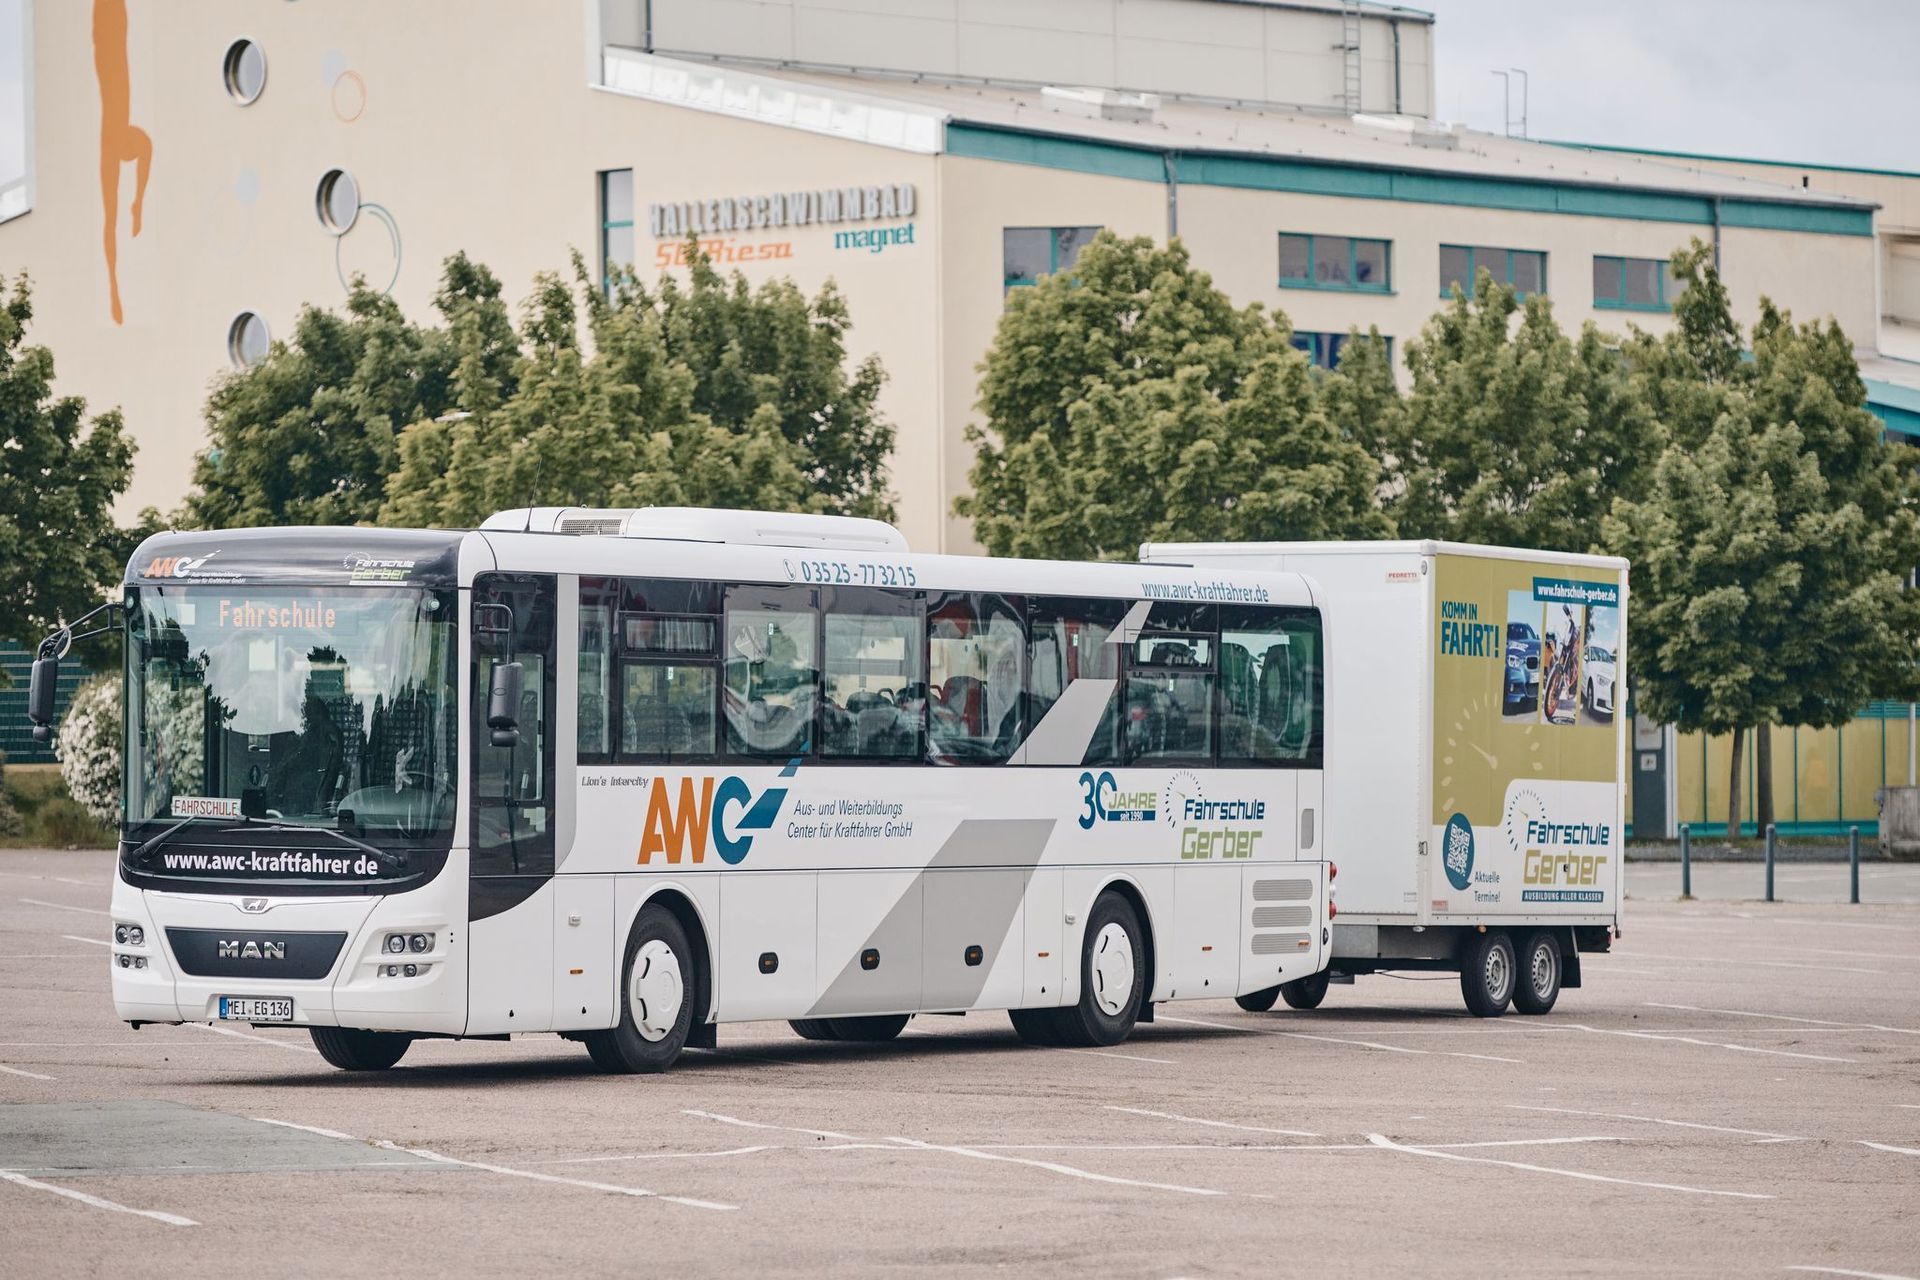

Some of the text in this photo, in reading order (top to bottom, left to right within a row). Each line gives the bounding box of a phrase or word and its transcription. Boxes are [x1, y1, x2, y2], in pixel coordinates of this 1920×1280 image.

[650, 183, 917, 238] HALLENSCHWIMMBAD
[834, 223, 914, 252] magnet
[143, 556, 193, 579] AWC
[351, 568, 411, 581] Gerber
[355, 559, 415, 572] Fahrschule
[1142, 580, 1269, 602] www.awc-kraftfahrer.de
[1537, 584, 1616, 603] www.fahrschule-gerber.de
[219, 599, 336, 629] Fahrschule
[1441, 600, 1478, 620] KOMM IN
[1441, 621, 1499, 658] FAHRT!
[581, 776, 607, 787] Lion's
[174, 799, 238, 816] FAHRSCHULE
[794, 799, 903, 819] Aus- und Weiterbildungs
[1078, 771, 1157, 829] 30 JAHRE
[1184, 798, 1265, 820] Fahrschule
[637, 775, 753, 865] AWC
[787, 820, 913, 838] Center für Kraftfahrer GmbH
[1526, 820, 1610, 845] Fahrschule
[1181, 827, 1263, 859] Gerber
[1474, 871, 1500, 883] Aktuelle
[1523, 849, 1607, 885] Gerber
[1474, 890, 1501, 903] Termine!
[1524, 891, 1602, 902] AUSBILDUNG ALLER KLASSEN
[218, 940, 285, 960] MAN
[227, 1001, 290, 1016] MEI EG 136
